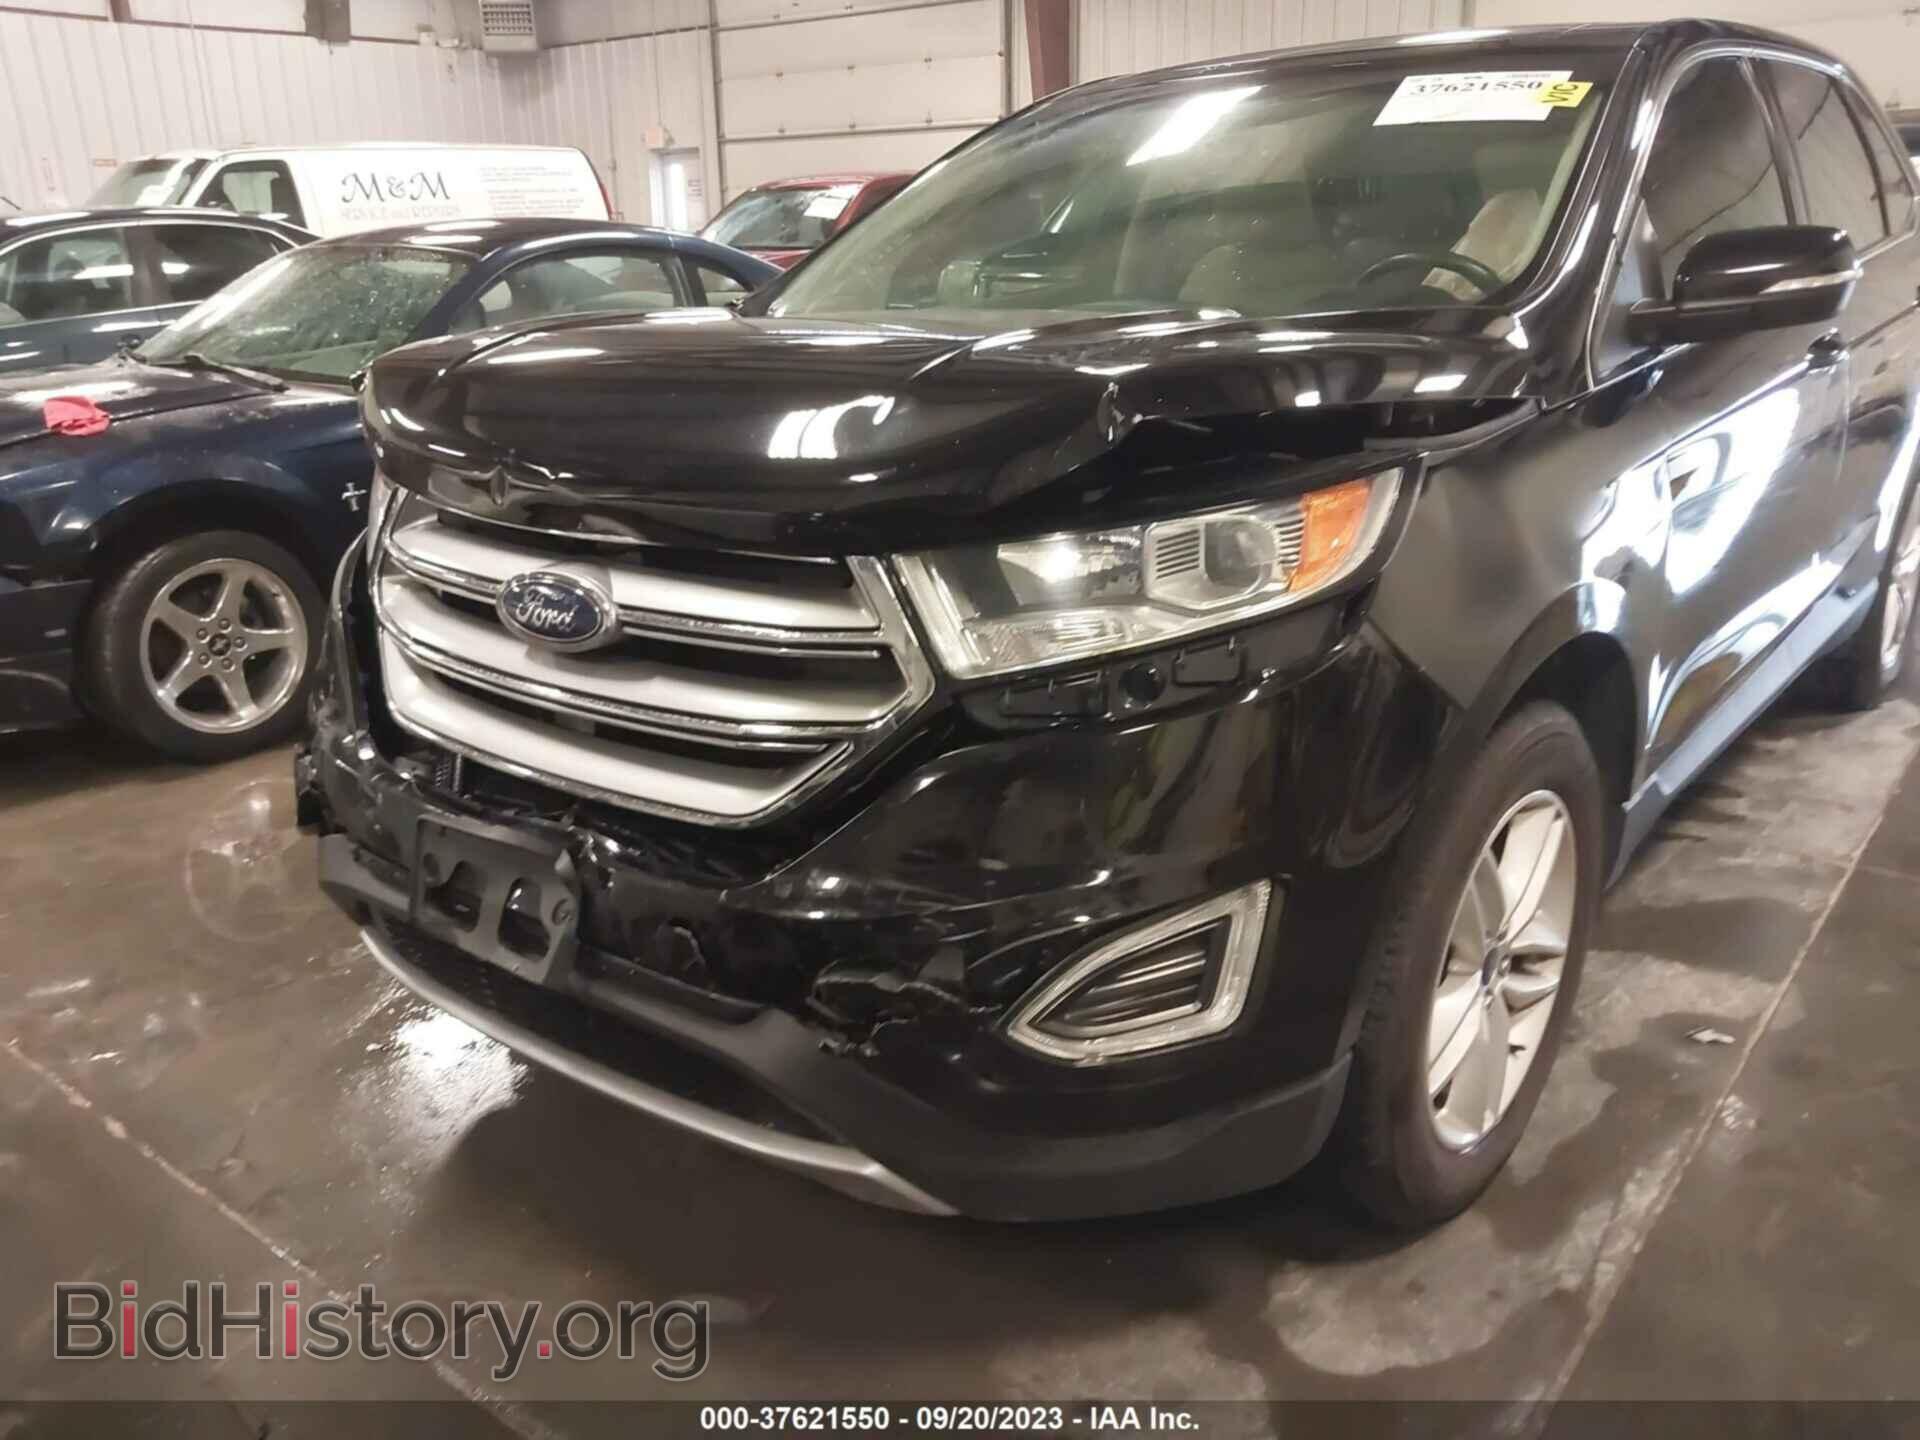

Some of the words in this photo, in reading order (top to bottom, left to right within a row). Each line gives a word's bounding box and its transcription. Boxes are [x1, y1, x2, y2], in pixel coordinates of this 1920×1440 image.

[1414, 80, 1543, 95] 37621550
[1541, 83, 1579, 103] VIC
[515, 585, 580, 632] Ford
